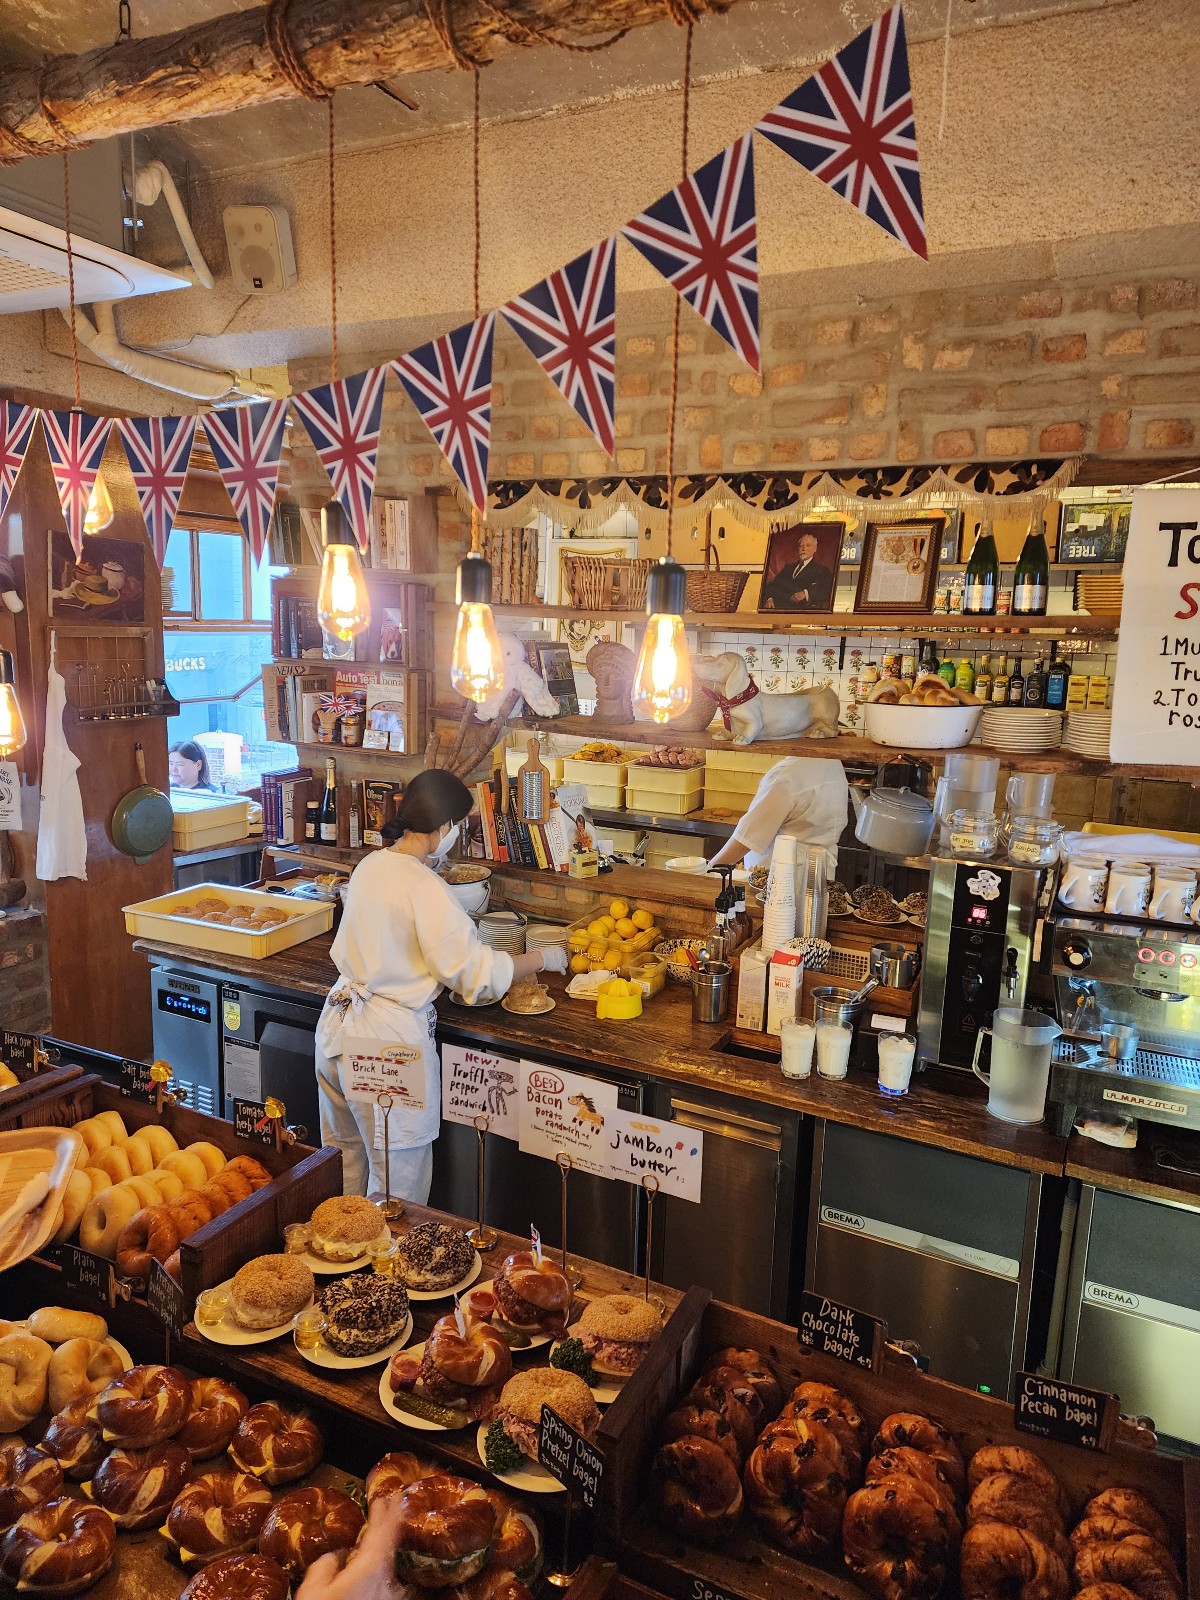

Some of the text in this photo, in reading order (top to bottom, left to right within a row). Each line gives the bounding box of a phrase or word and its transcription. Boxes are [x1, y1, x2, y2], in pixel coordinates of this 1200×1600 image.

[1068, 545, 1097, 558] TREE
[335, 670, 380, 685] Auto Test
[774, 980, 791, 989] MILK
[10, 1046, 25, 1059] bagel
[121, 1060, 137, 1077] Salt
[352, 1060, 399, 1077] Brick Lane
[451, 1062, 489, 1087] Truffle
[449, 1080, 480, 1096] pepper
[533, 1073, 558, 1092] BEST
[449, 1096, 487, 1112] sandwich
[526, 1085, 563, 1110] Bacon
[235, 1102, 265, 1118] Tomato
[535, 1106, 563, 1121] potato
[236, 1113, 252, 1133] herb
[545, 1120, 580, 1139] sandwich
[610, 1130, 673, 1159] jambon
[630, 1153, 677, 1176] butter
[827, 1210, 861, 1227] BREMA
[73, 1250, 96, 1270] Plain
[79, 1267, 100, 1287] bagel
[1093, 1287, 1133, 1306] BREMA
[820, 1299, 855, 1327] Dark
[801, 1311, 860, 1348] Chocolate
[823, 1335, 855, 1361] bagel
[1024, 1377, 1097, 1409] Cinnamon
[1020, 1393, 1058, 1419] Pecan
[1065, 1405, 1098, 1428] bagel
[542, 1408, 574, 1450] Spring
[576, 1438, 603, 1477] Onion
[541, 1428, 570, 1469] Pretzel
[572, 1457, 598, 1495] bagel
